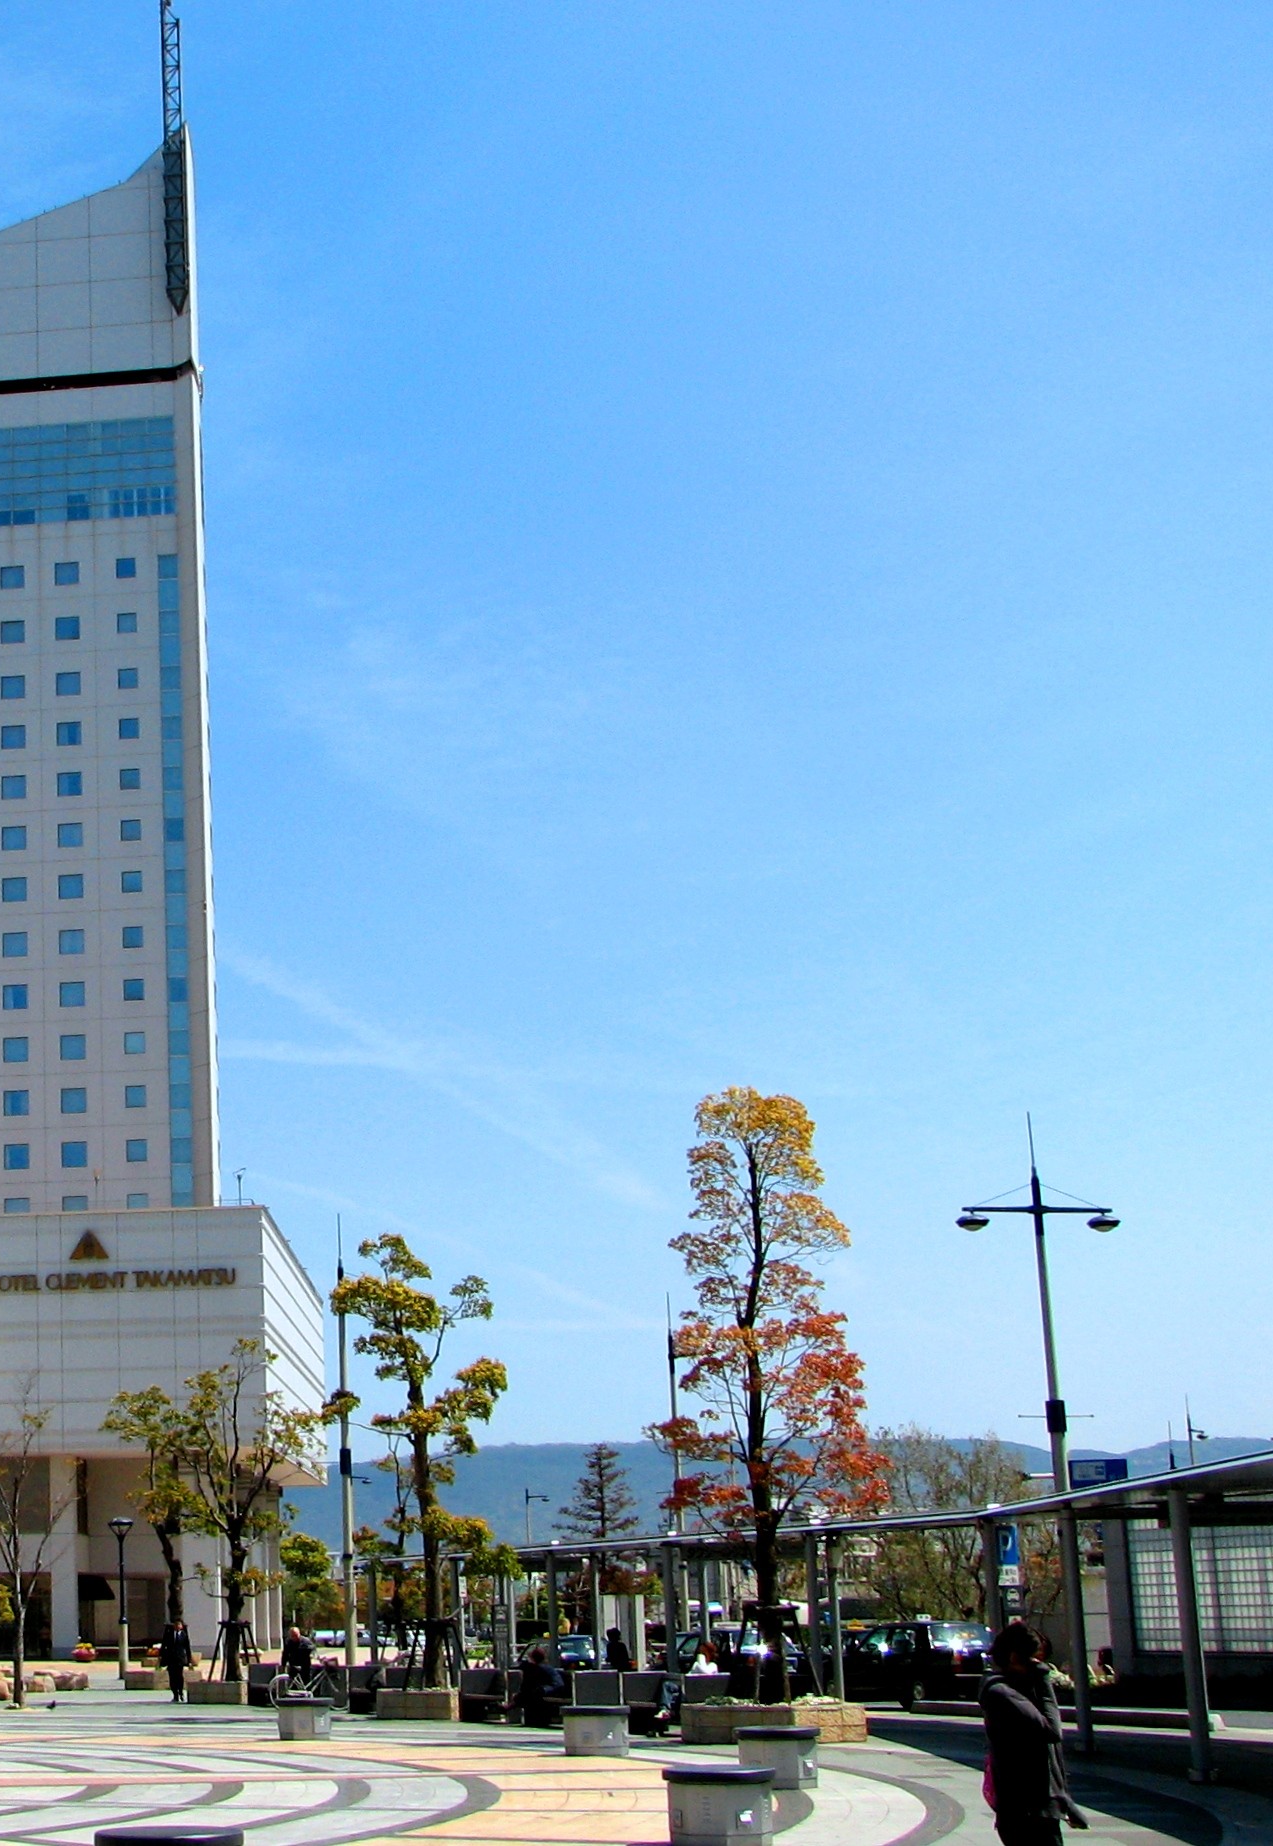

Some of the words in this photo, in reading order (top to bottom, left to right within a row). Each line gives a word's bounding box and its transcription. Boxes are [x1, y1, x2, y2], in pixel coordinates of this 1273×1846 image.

[45, 1271, 128, 1291] CLEMENT
[132, 1268, 236, 1288] TAKAMATSU
[999, 1529, 1012, 1561] P
